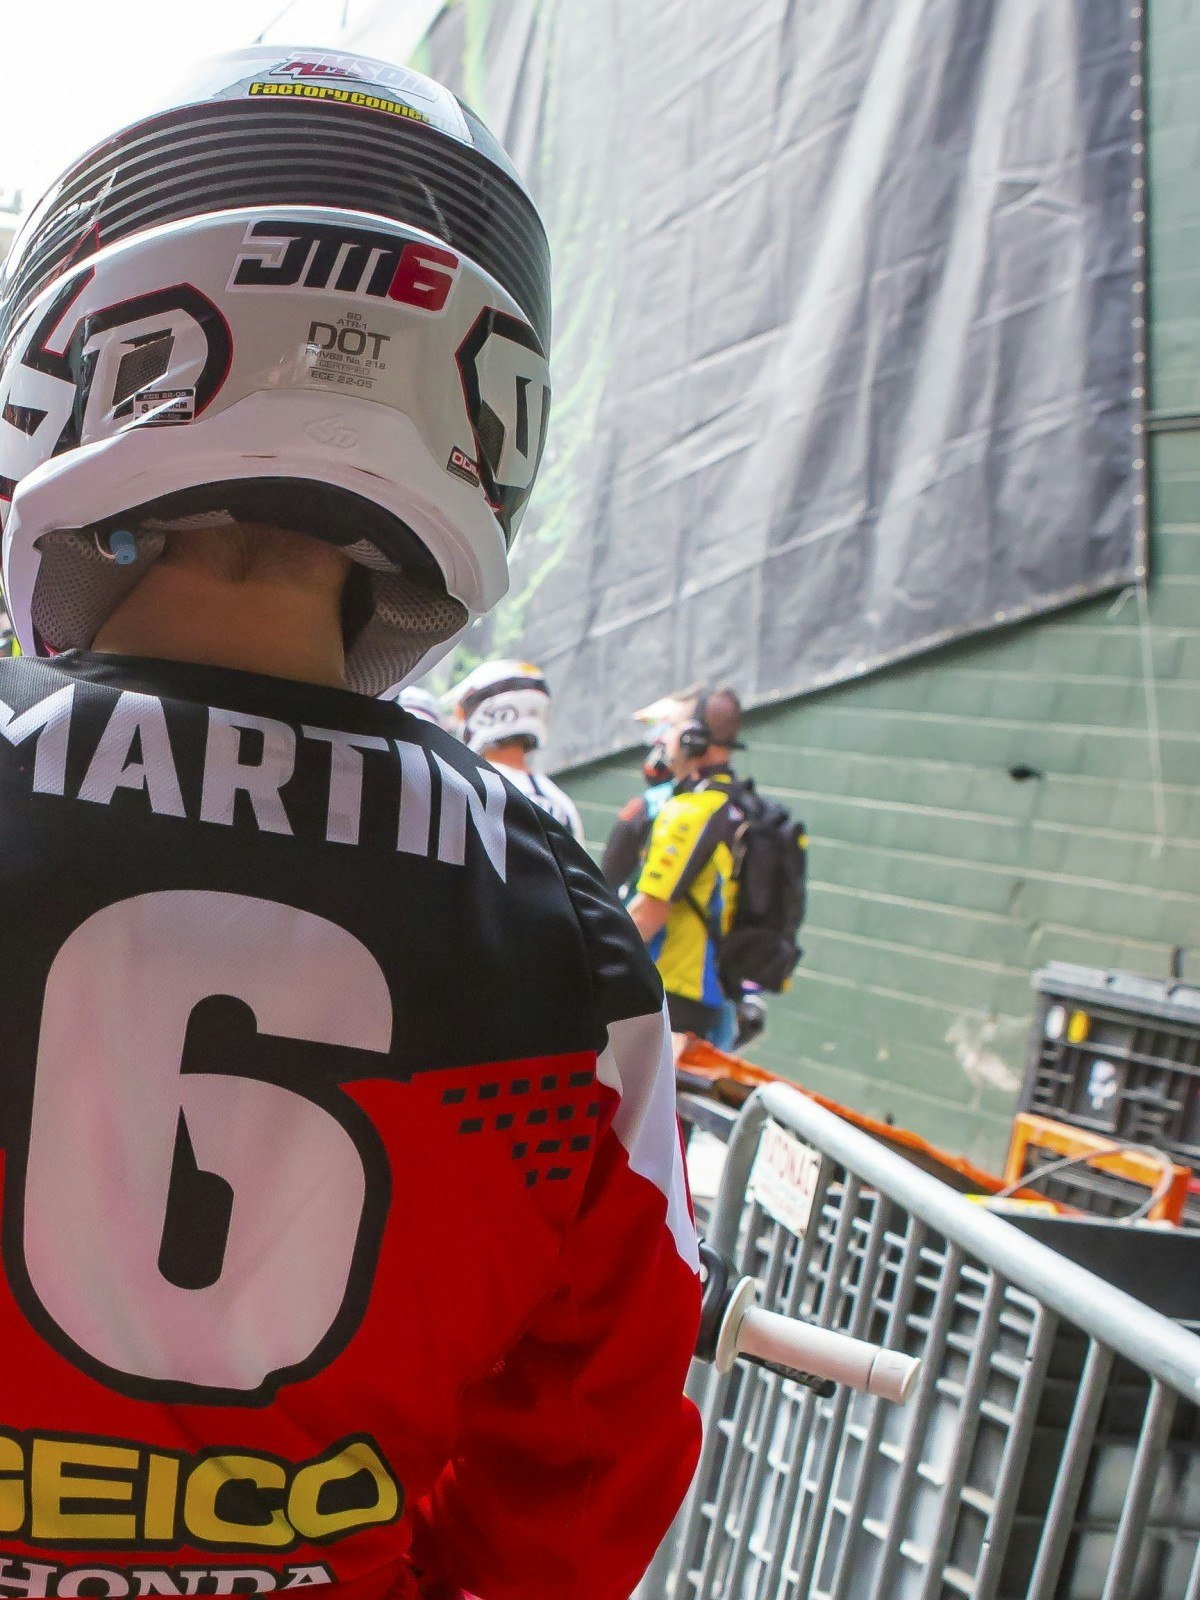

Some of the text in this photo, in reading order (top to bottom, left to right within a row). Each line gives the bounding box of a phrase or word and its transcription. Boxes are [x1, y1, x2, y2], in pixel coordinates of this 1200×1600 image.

[307, 321, 391, 361] DOT
[311, 370, 335, 382] ECE
[320, 360, 370, 376] CERTIFIED
[22, 889, 394, 1392] 6
